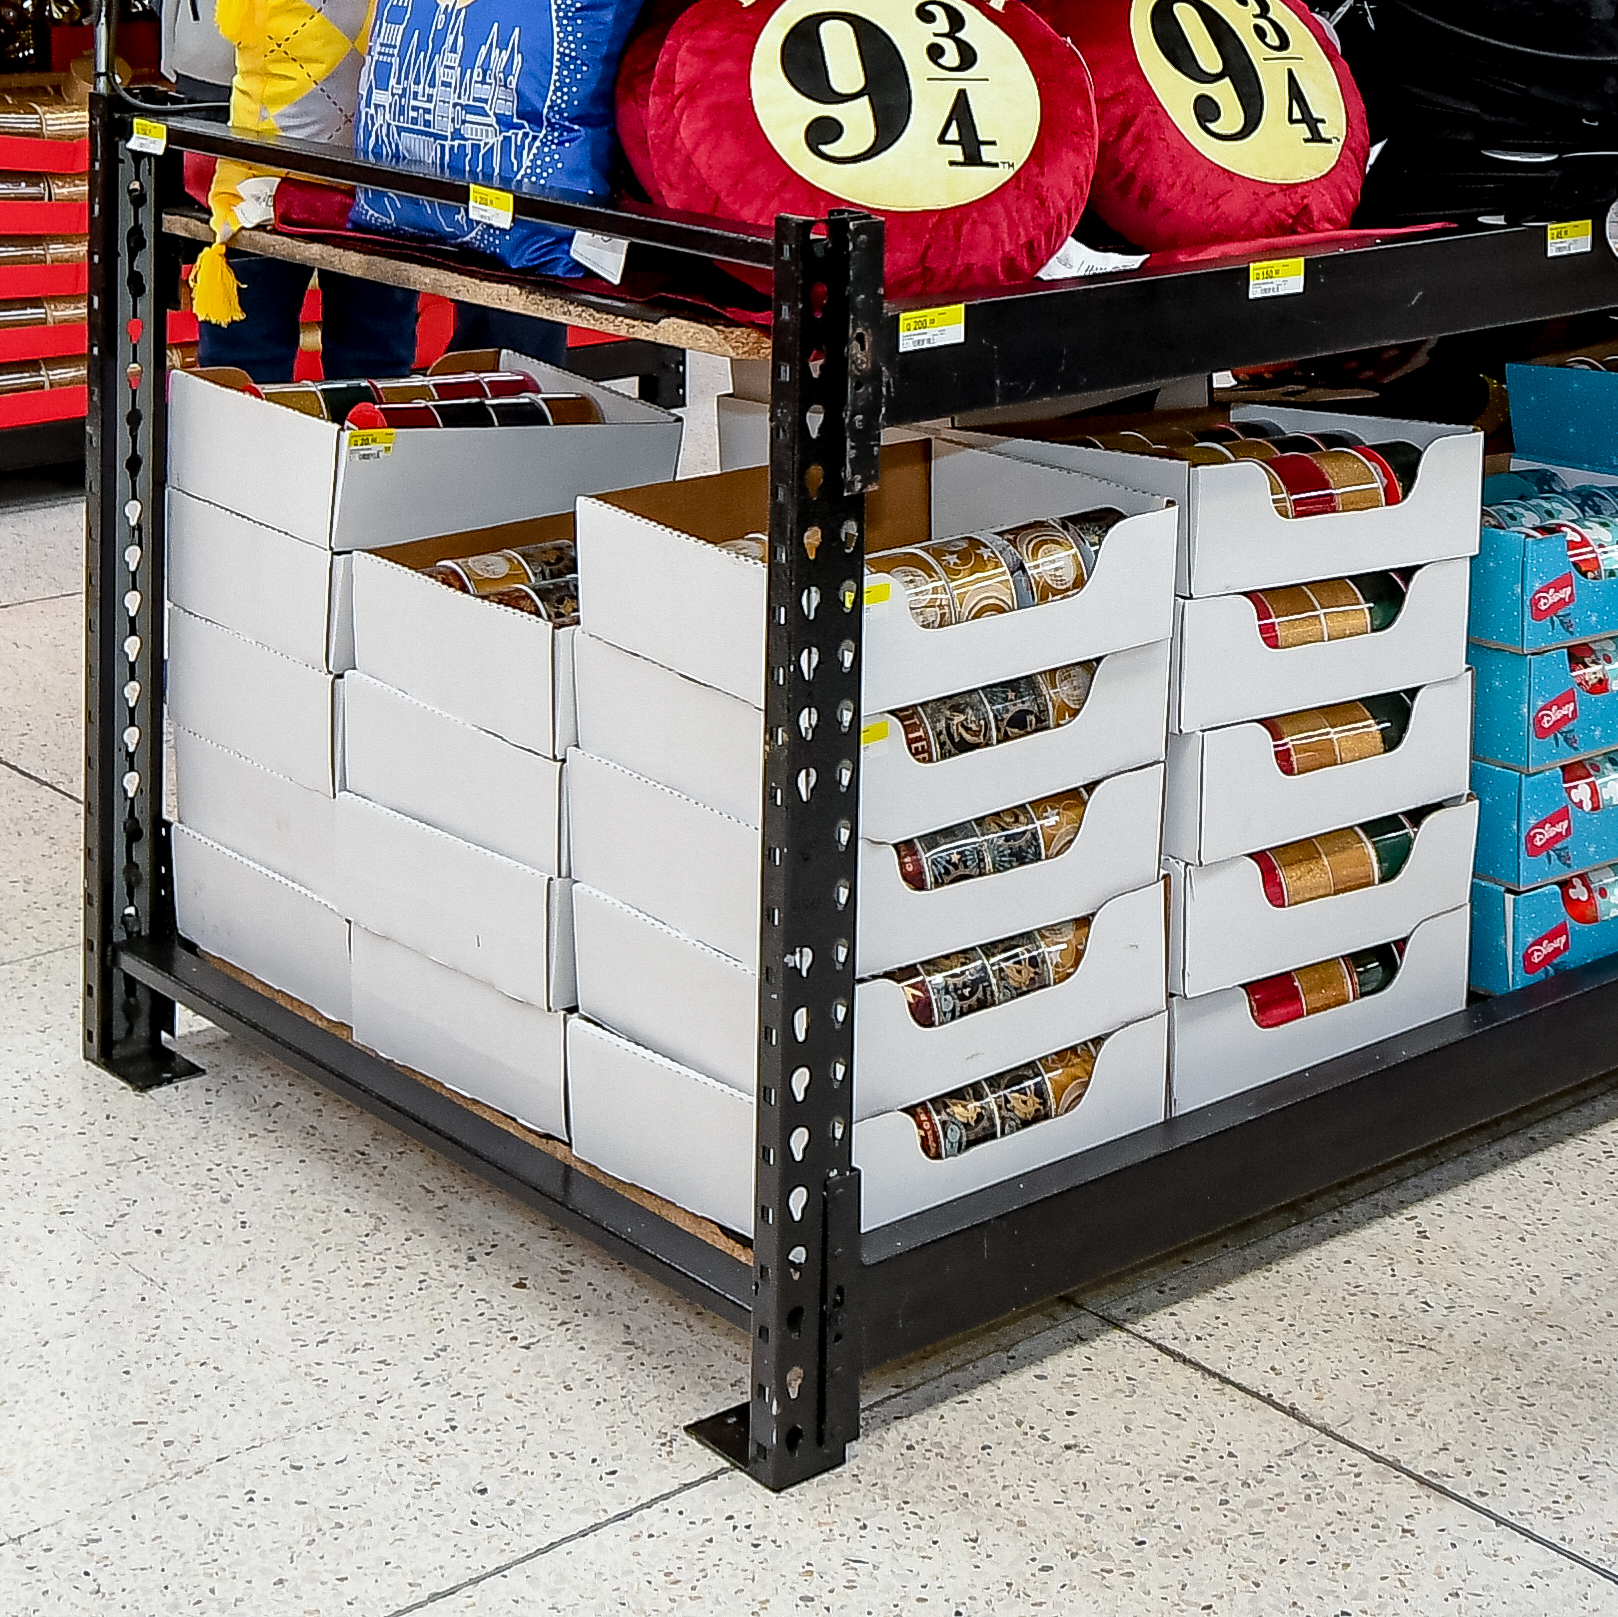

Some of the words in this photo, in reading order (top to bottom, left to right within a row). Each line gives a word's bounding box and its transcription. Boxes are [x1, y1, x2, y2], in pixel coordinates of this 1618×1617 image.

[780, 11, 913, 165] 9
[1535, 585, 1572, 611] Disney
[1537, 701, 1575, 729] Disney
[1530, 819, 1569, 847] Disney
[1528, 934, 1567, 964] Disney
